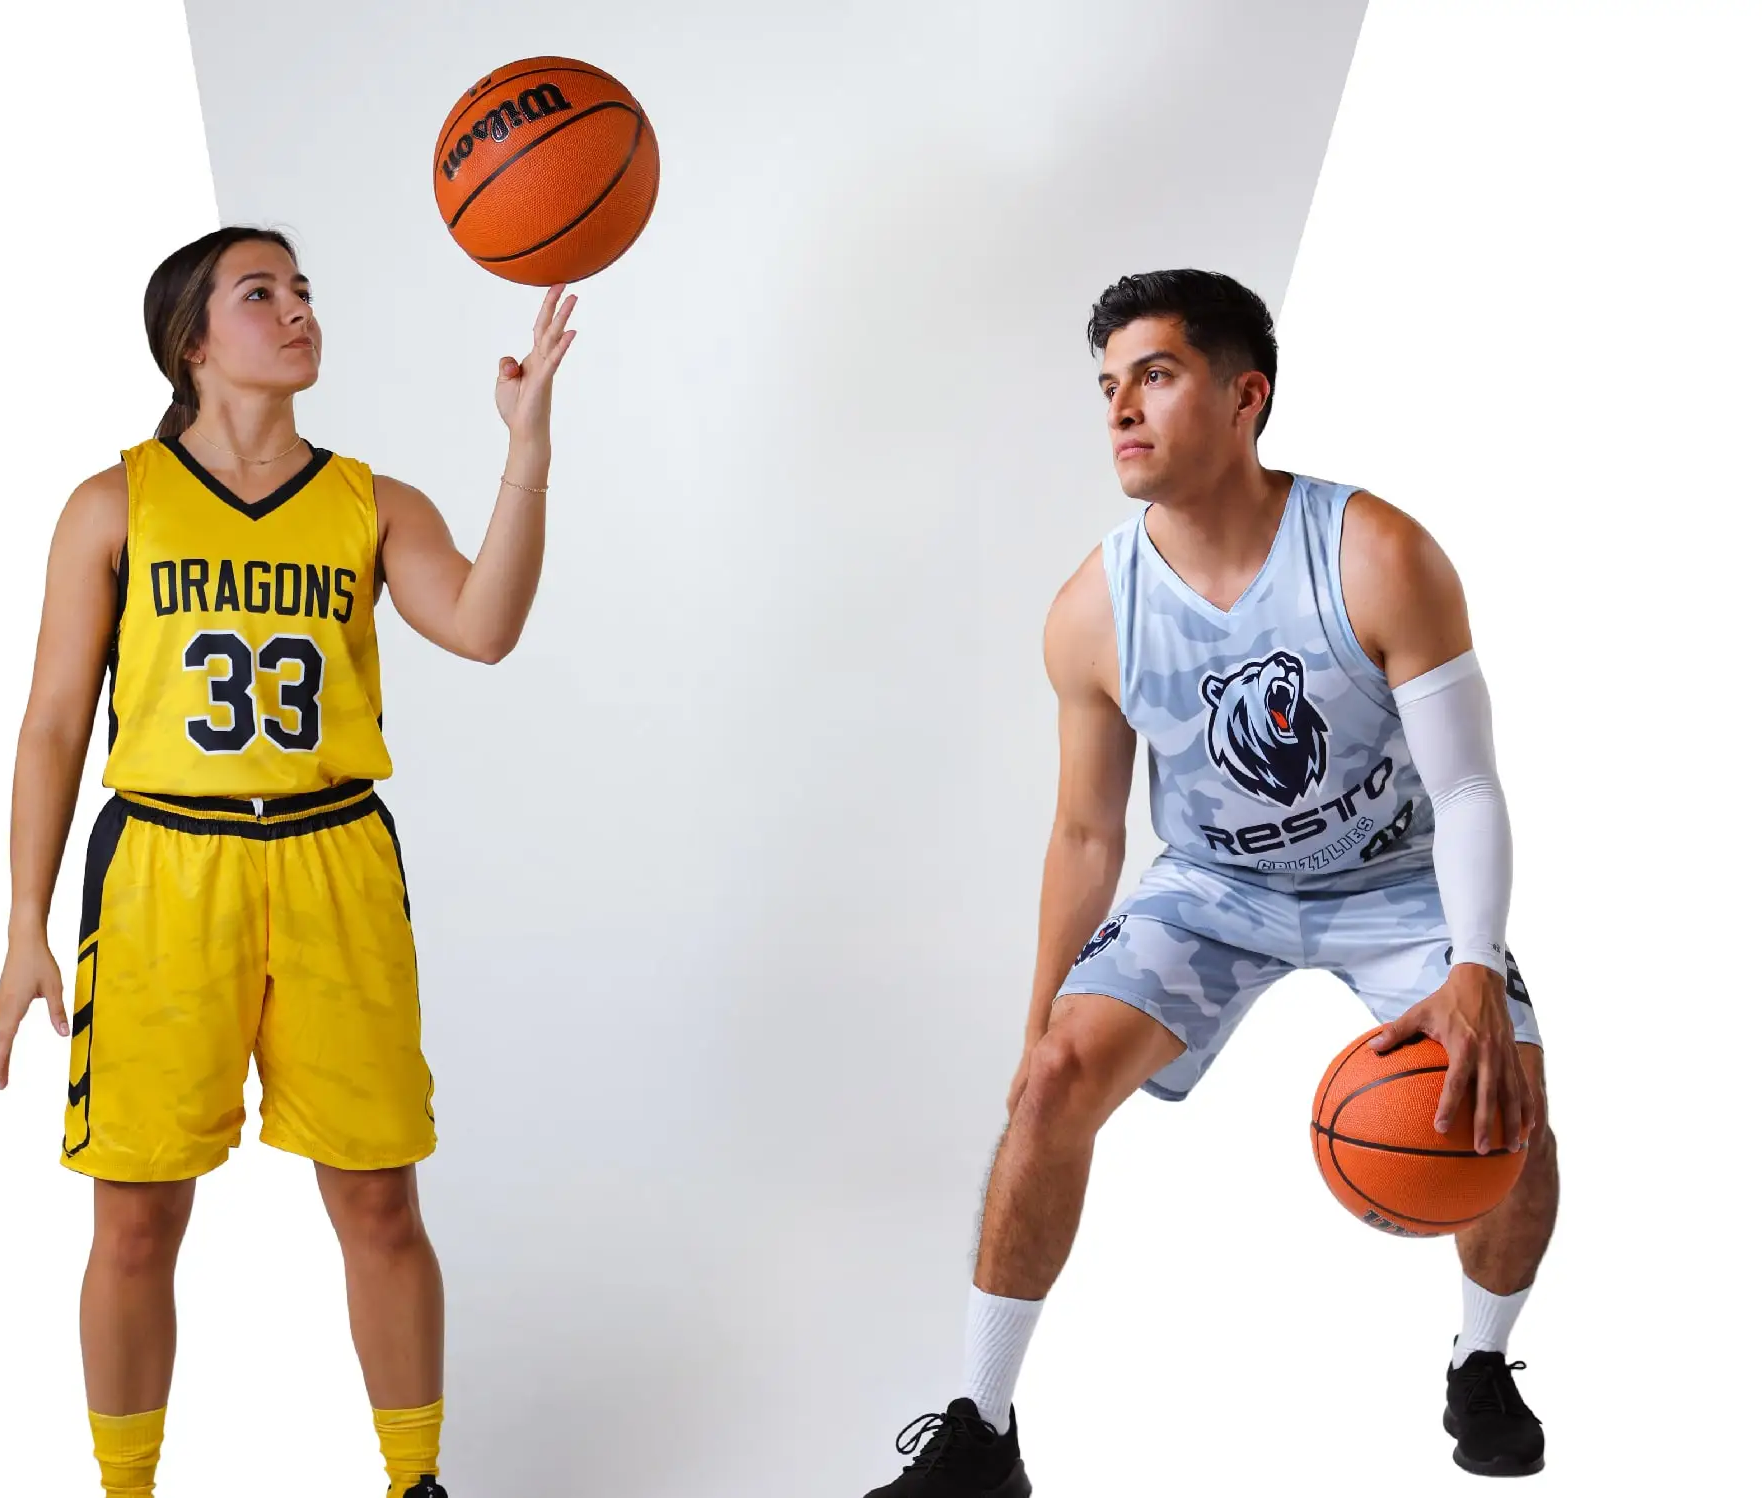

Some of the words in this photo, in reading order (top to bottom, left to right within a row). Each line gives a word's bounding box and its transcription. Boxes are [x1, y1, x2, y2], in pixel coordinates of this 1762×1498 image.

[442, 83, 573, 181] Wilson
[151, 559, 356, 624] DRAGONS
[182, 629, 325, 755] 33
